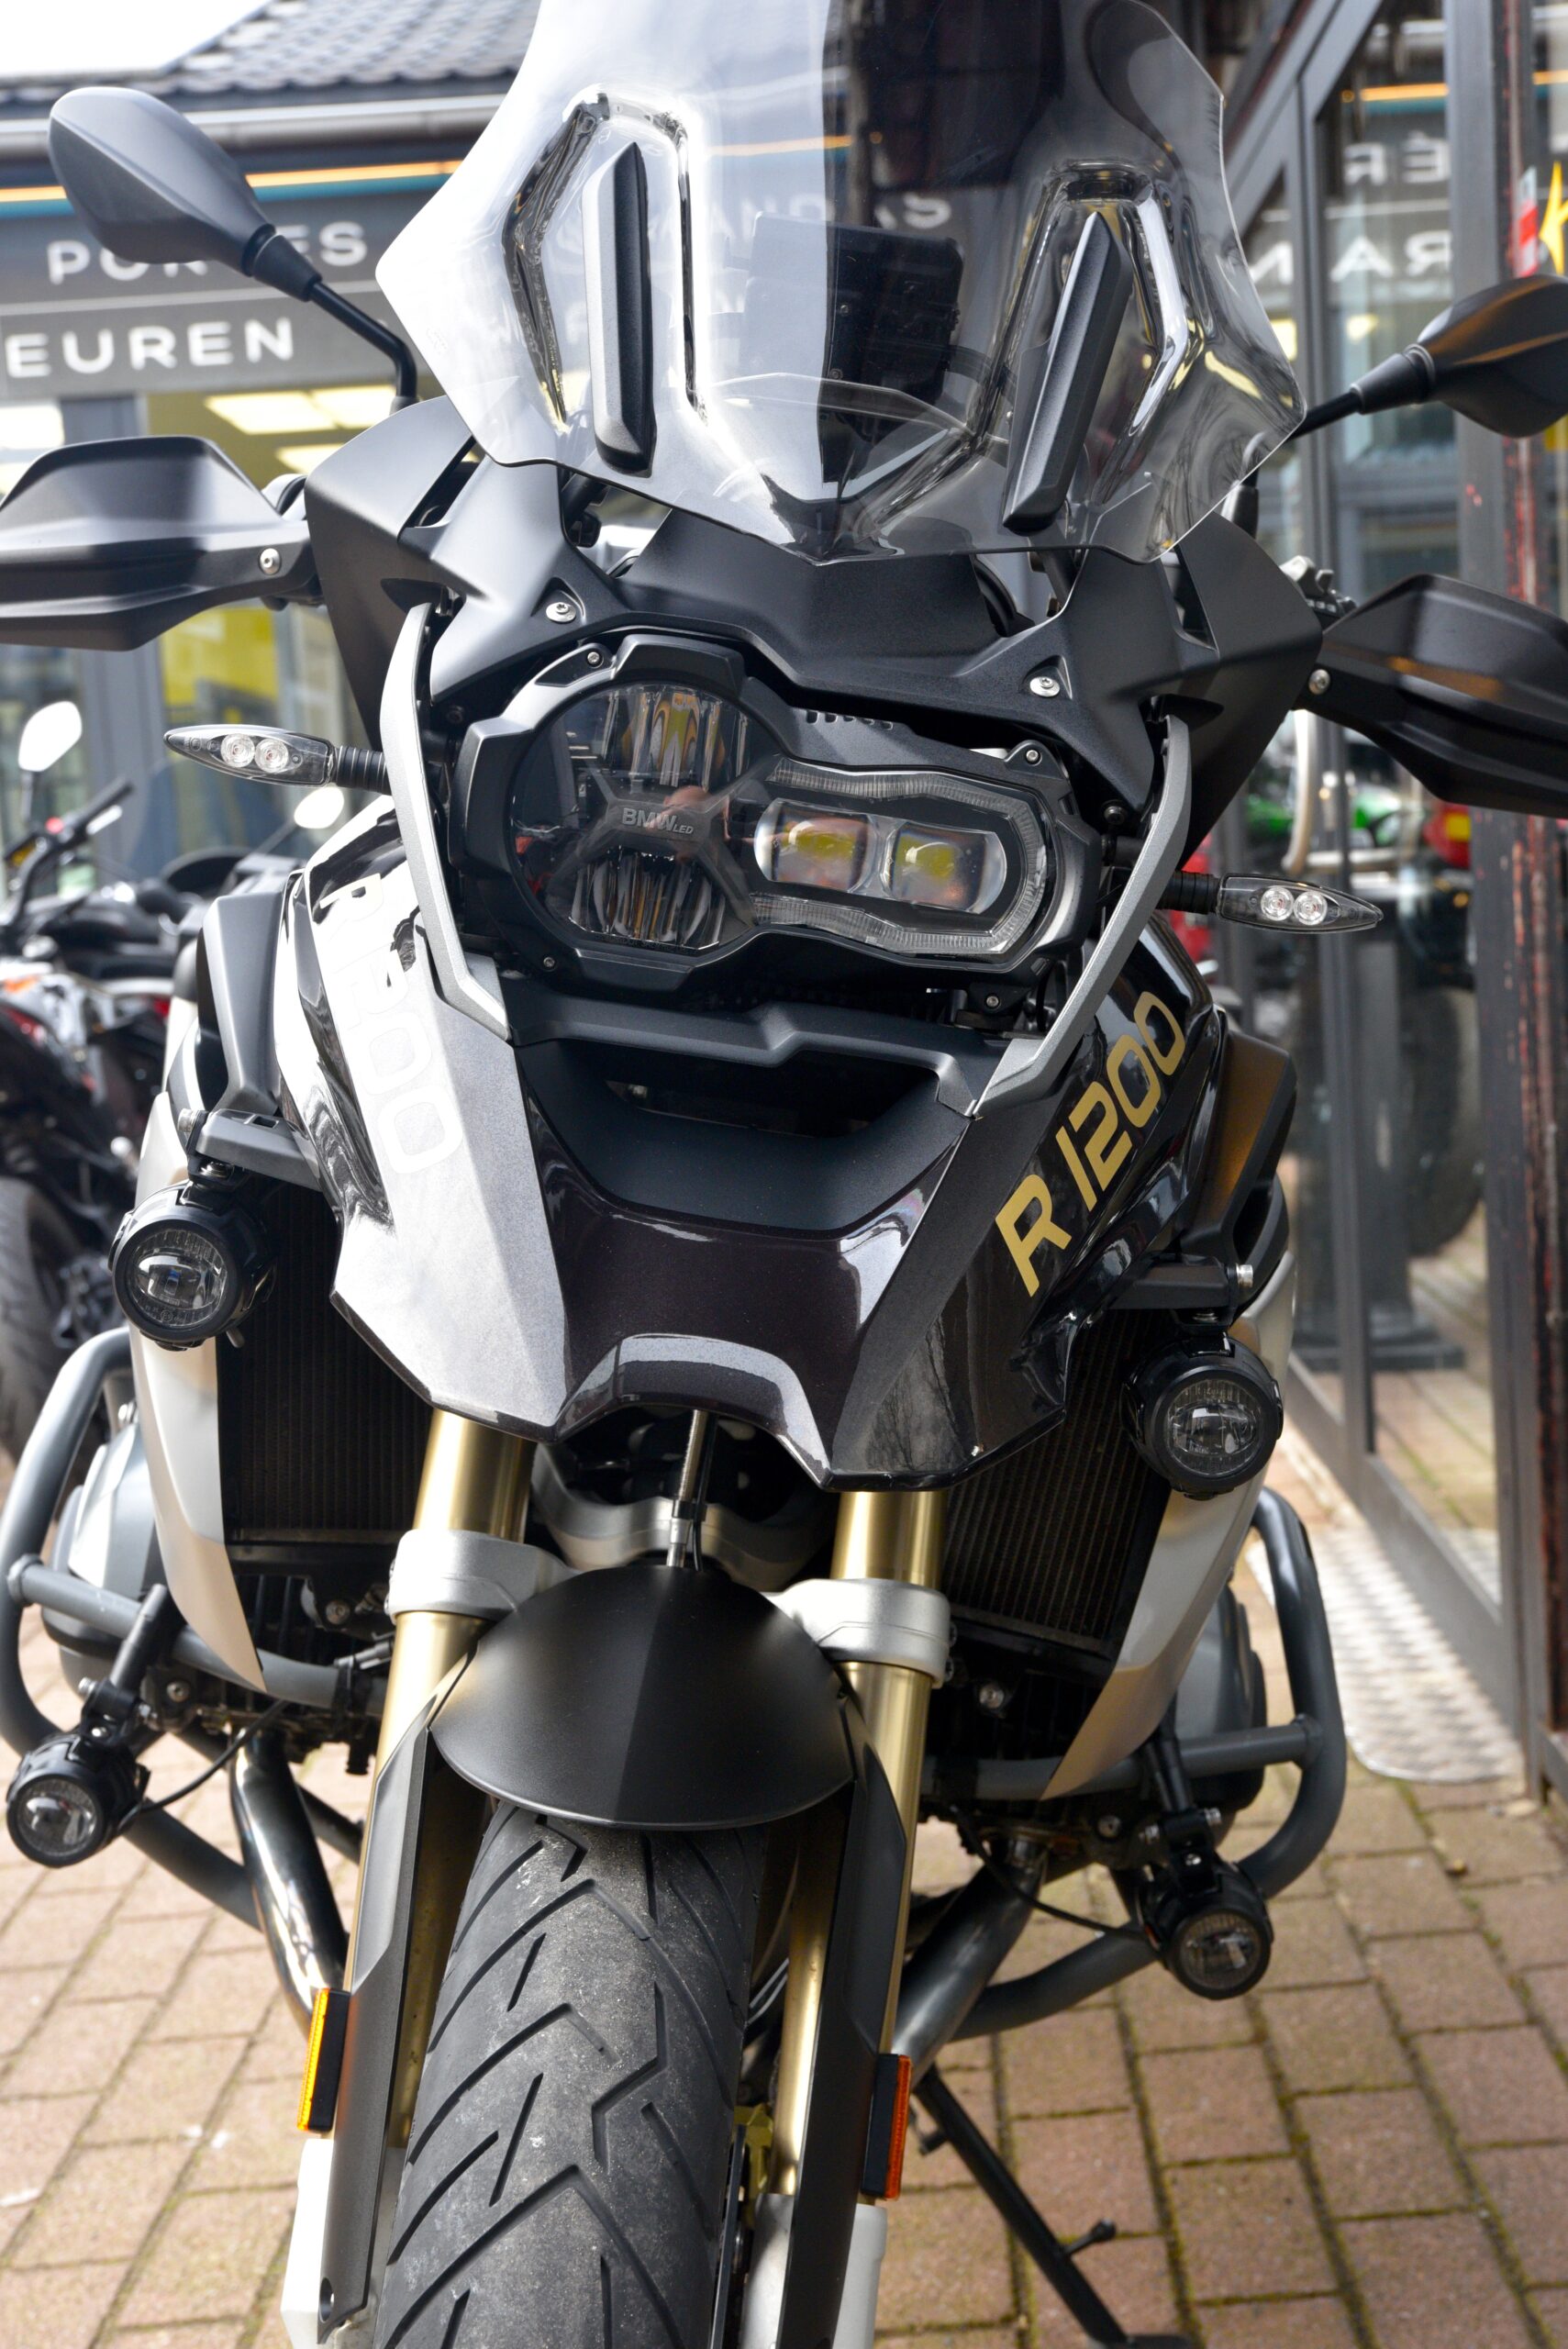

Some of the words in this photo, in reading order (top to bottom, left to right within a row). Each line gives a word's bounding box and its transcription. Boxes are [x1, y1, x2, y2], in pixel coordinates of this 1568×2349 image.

[622, 807, 677, 831] BMW
[673, 825, 694, 835] LED
[995, 1174, 1073, 1297] R
[1055, 991, 1186, 1212] 1200
